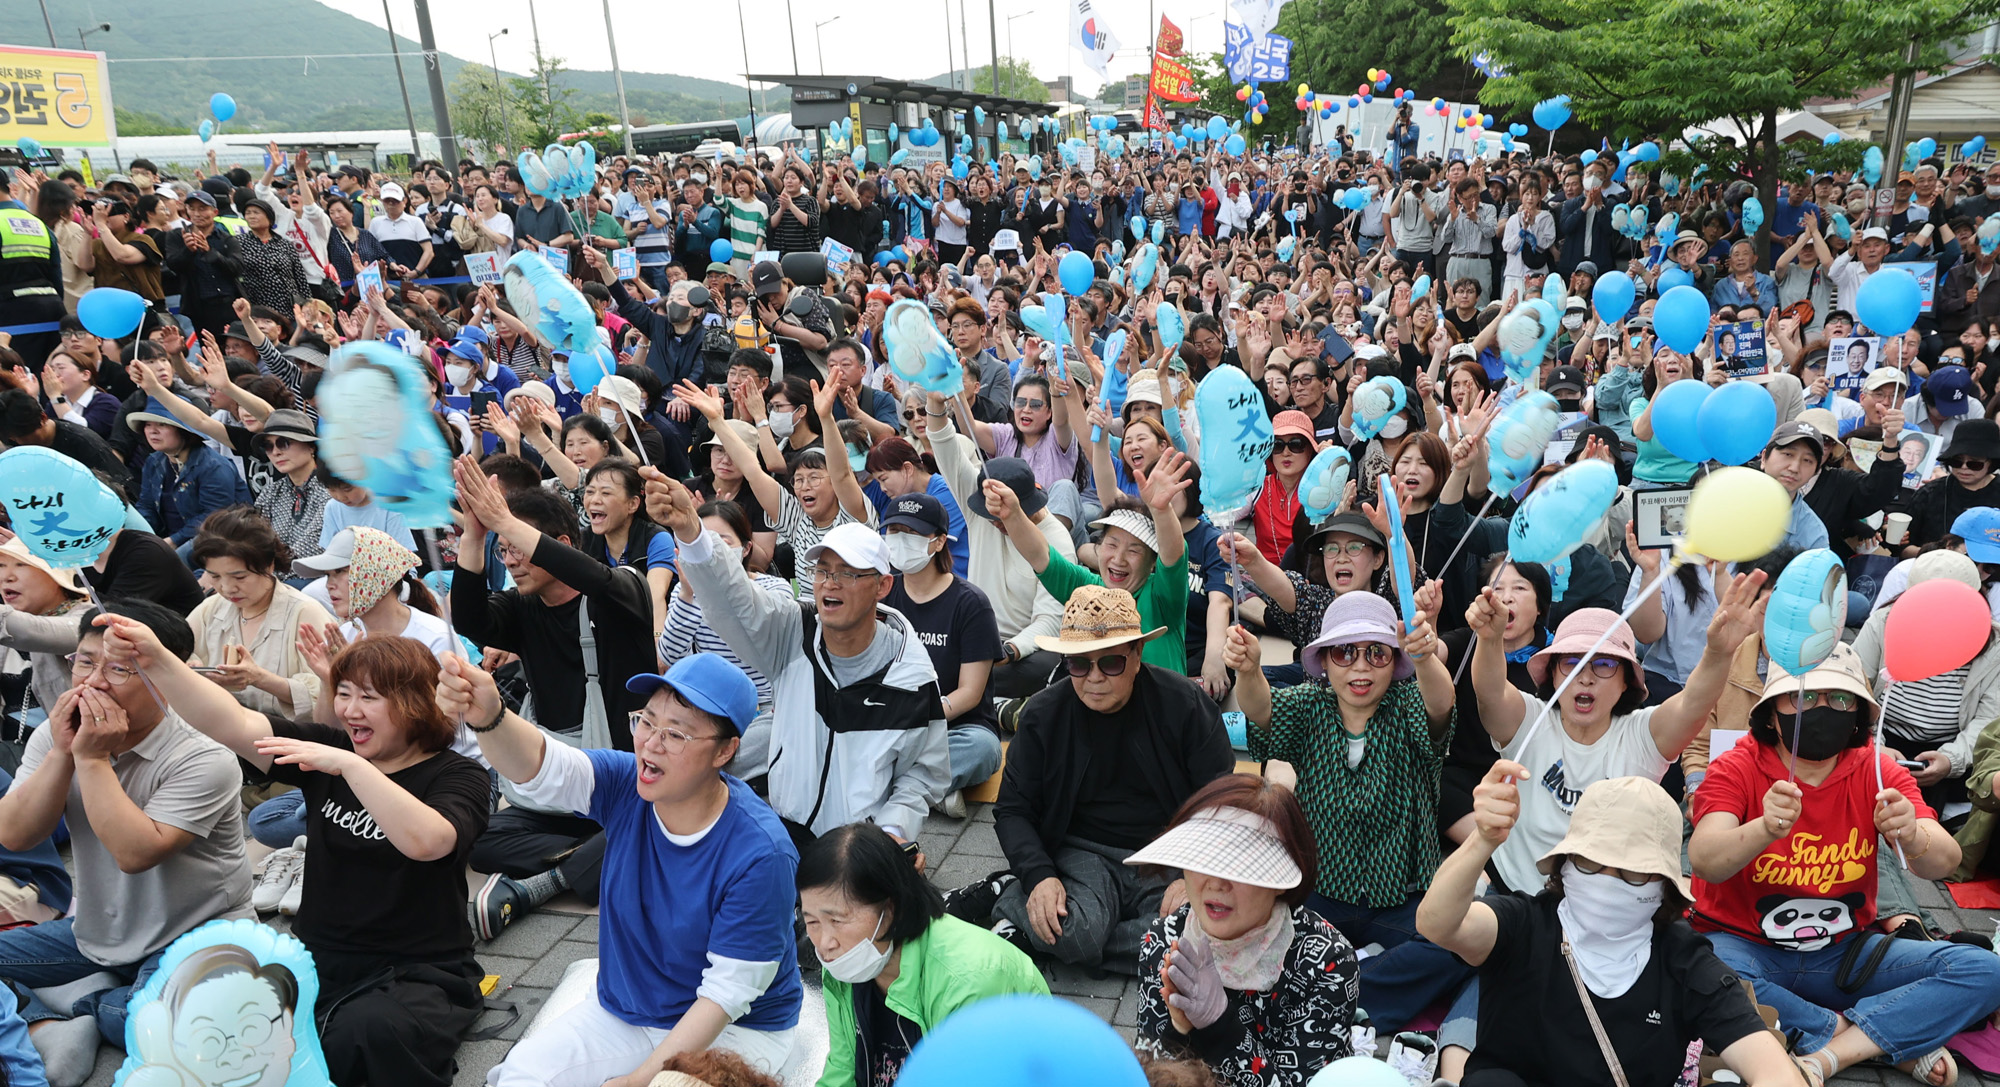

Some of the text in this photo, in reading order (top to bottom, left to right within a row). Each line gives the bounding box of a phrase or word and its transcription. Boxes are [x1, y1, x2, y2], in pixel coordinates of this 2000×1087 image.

[1154, 69, 1179, 95] 윤석열
[487, 256, 496, 272] 1
[1739, 348, 1763, 358] 대한민국
[1828, 372, 1836, 388] 1
[1228, 391, 1258, 411] 다시
[1231, 408, 1269, 442] 大
[12, 492, 64, 509] 다시
[1640, 496, 1667, 505] 투표해야
[28, 511, 93, 537] 大
[40, 526, 113, 552] 한민국
[920, 632, 948, 646] COAST
[1752, 853, 1841, 894] Funny
